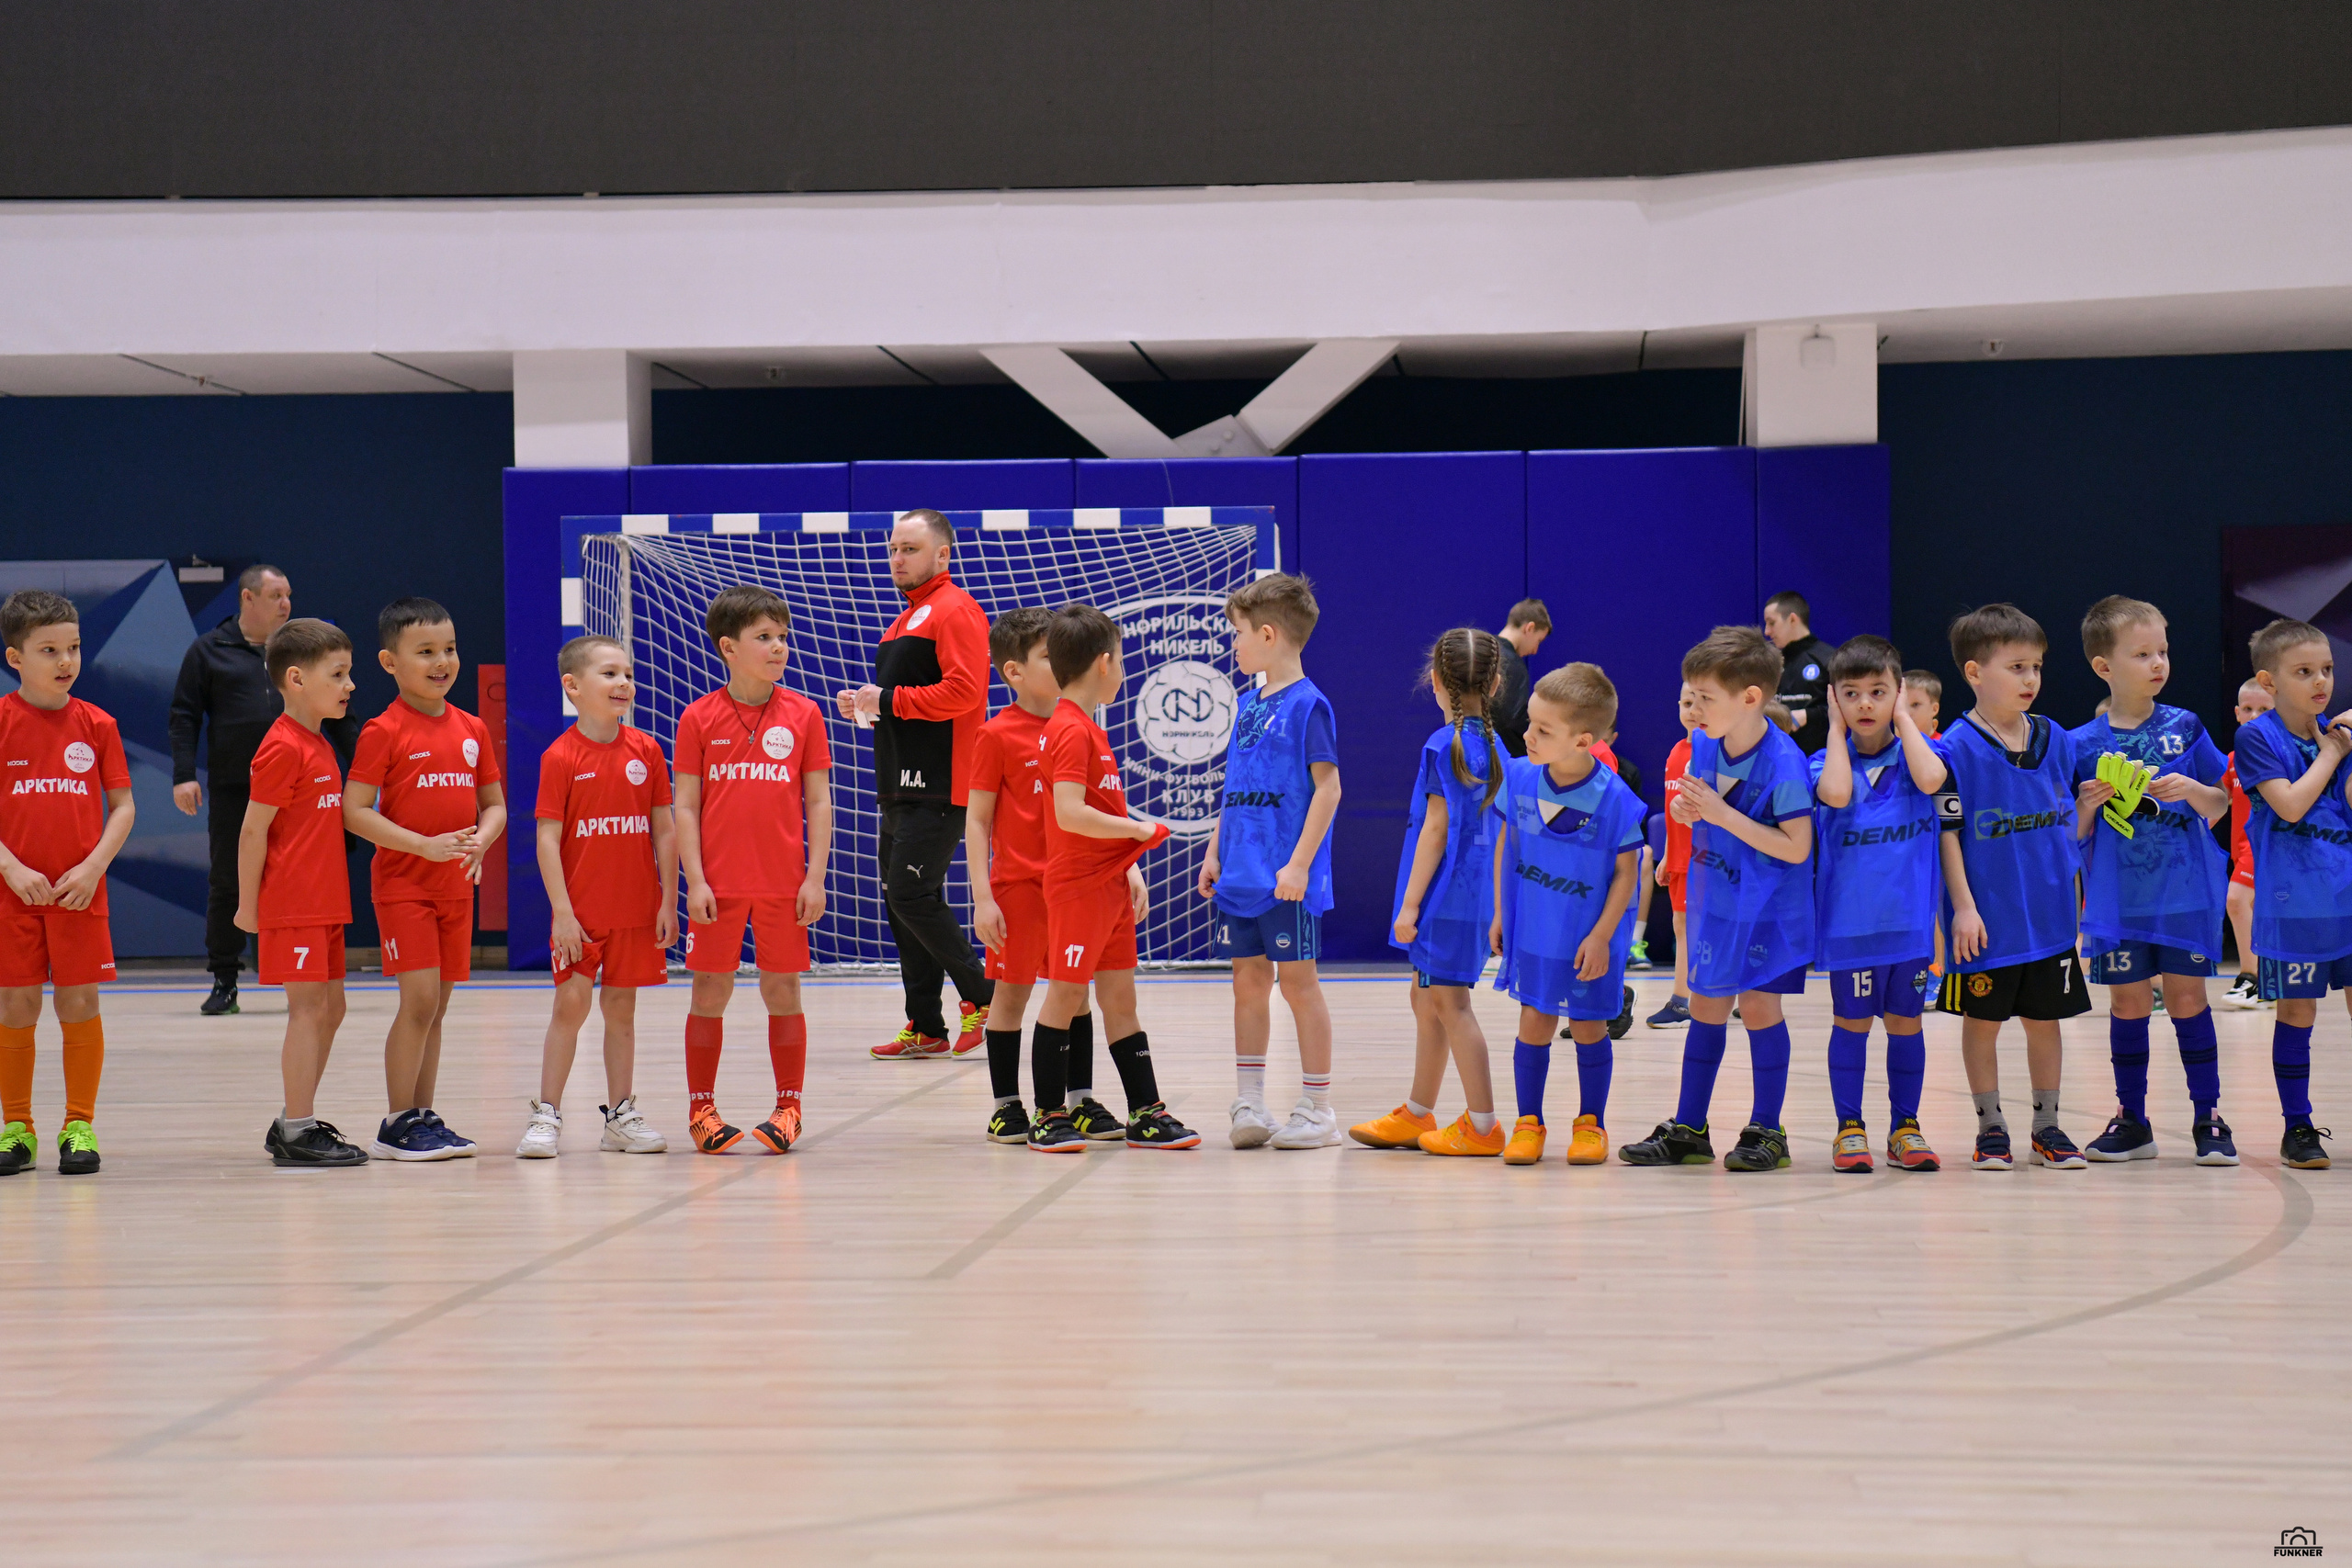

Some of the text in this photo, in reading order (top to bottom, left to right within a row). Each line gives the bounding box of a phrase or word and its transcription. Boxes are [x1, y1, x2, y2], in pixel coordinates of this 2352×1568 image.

[1150, 638, 1225, 655] НИКЕЛЬ
[2159, 735, 2184, 754] 13
[709, 762, 790, 782] АРКТИКА
[900, 769, 926, 788] И.А.
[1123, 756, 1227, 785] МИНИ-ФУТБОЛЬ
[12, 778, 88, 795] АРКТИКА
[1162, 789, 1216, 804] КЛУБ
[1173, 807, 1204, 818] 1993
[1944, 797, 1959, 814] C
[575, 816, 650, 838] АРКТИКА
[1841, 815, 1935, 847] DEMIX
[2106, 814, 2131, 832] DEMIX
[293, 947, 311, 970] 7
[384, 938, 399, 961] 11
[1065, 943, 1085, 967] 17
[2107, 952, 2132, 972] 13
[2060, 958, 2072, 994] 7
[2288, 962, 2316, 984] 27
[1851, 970, 1872, 998] 15
